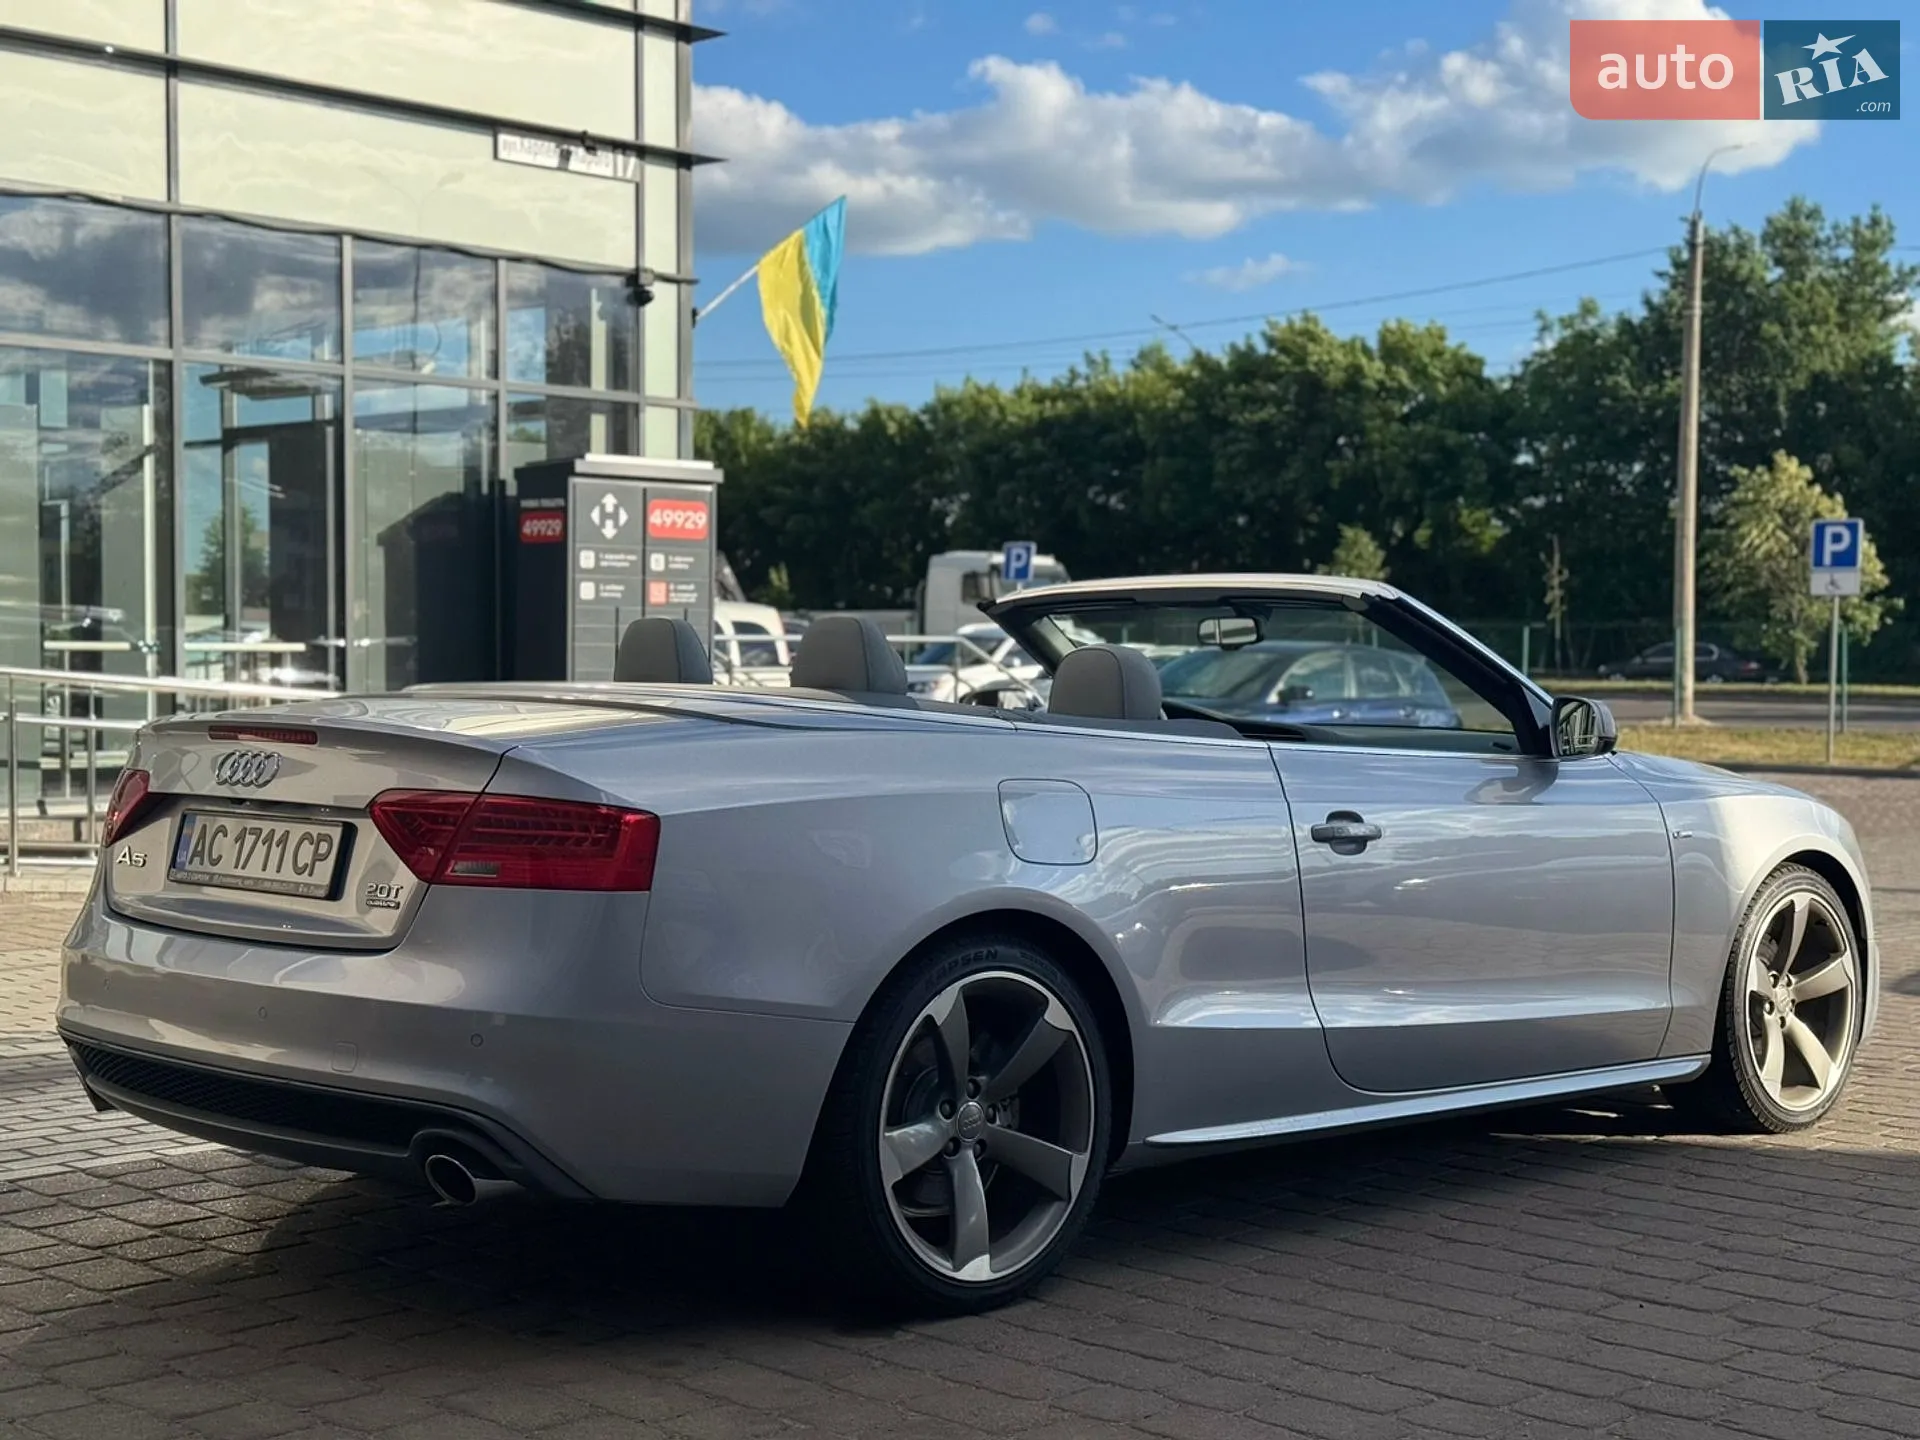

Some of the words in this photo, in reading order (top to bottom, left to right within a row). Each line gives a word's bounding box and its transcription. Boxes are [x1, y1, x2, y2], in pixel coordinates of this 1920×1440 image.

[522, 519, 563, 536] 49929
[650, 508, 708, 530] 49929
[1823, 525, 1853, 567] P
[1009, 550, 1027, 580] P
[116, 846, 148, 868] A5
[188, 823, 228, 867] AC
[234, 825, 290, 873] 1711
[292, 831, 334, 877] CP
